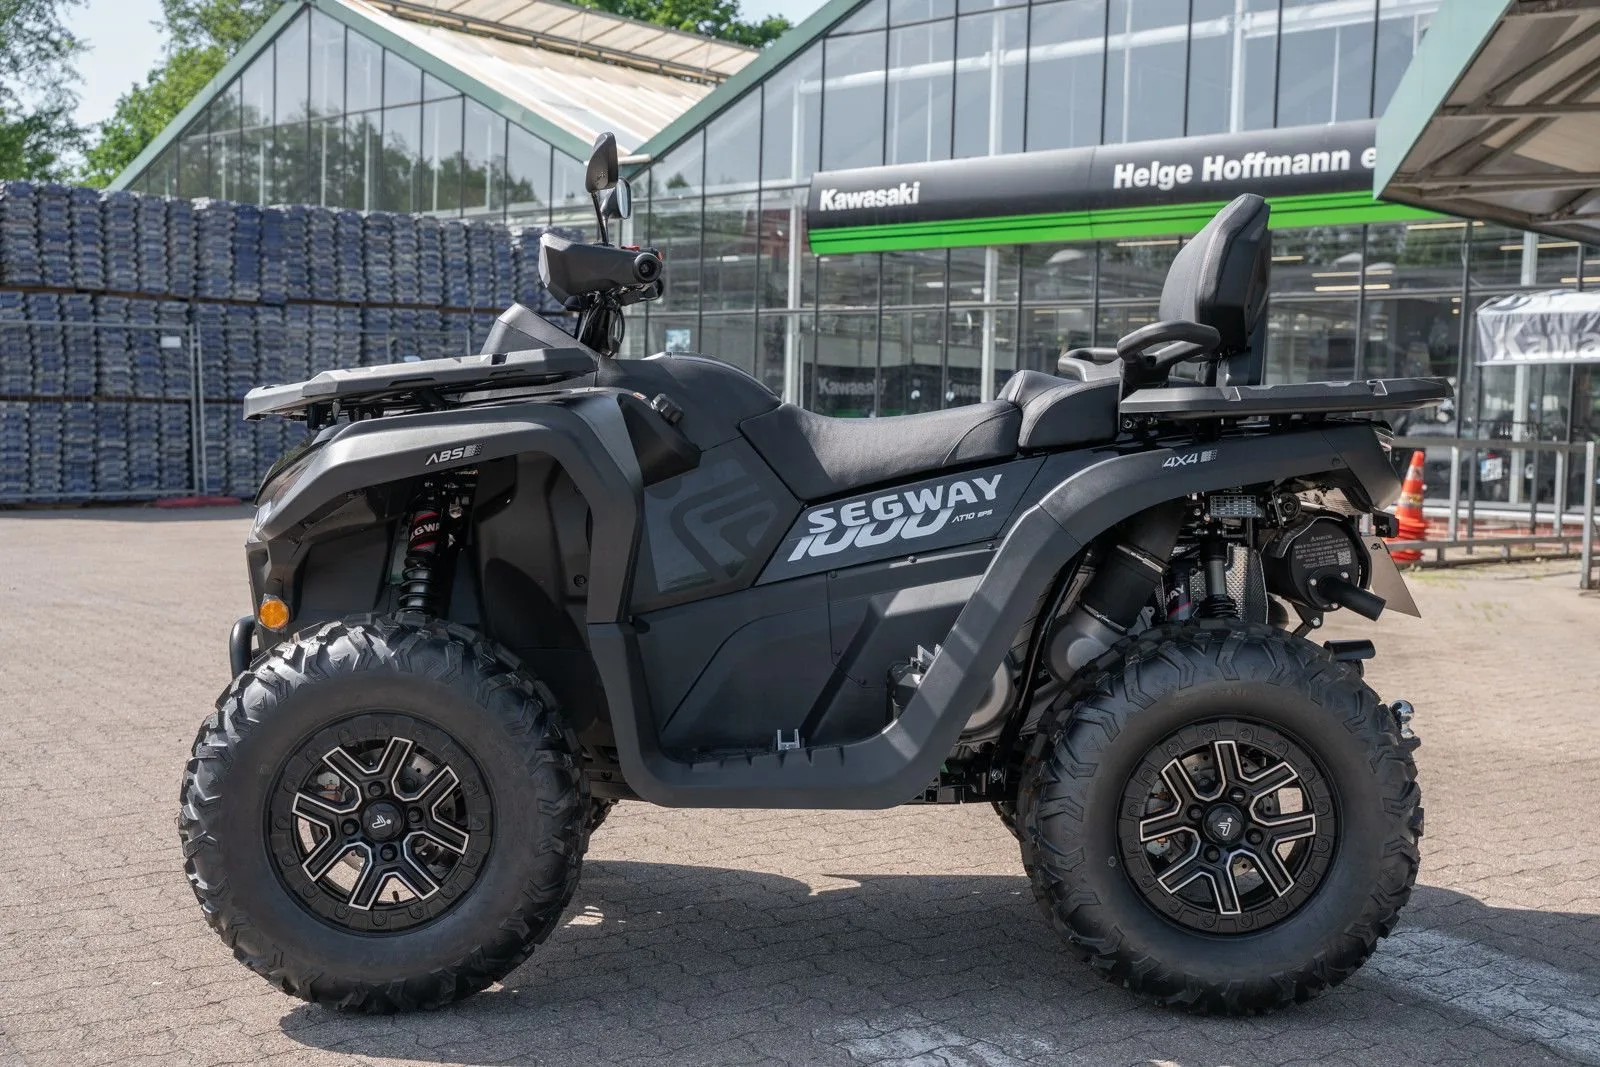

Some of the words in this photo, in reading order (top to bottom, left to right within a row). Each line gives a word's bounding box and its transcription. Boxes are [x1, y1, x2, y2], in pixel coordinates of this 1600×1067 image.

[1113, 161, 1193, 190] Helge
[1202, 150, 1350, 182] Hoffmann
[820, 181, 920, 211] Kawasaki
[425, 447, 465, 465] ABS
[1162, 453, 1198, 468] 4X4
[807, 474, 1002, 534] SEGWAY
[951, 512, 975, 524] AT10
